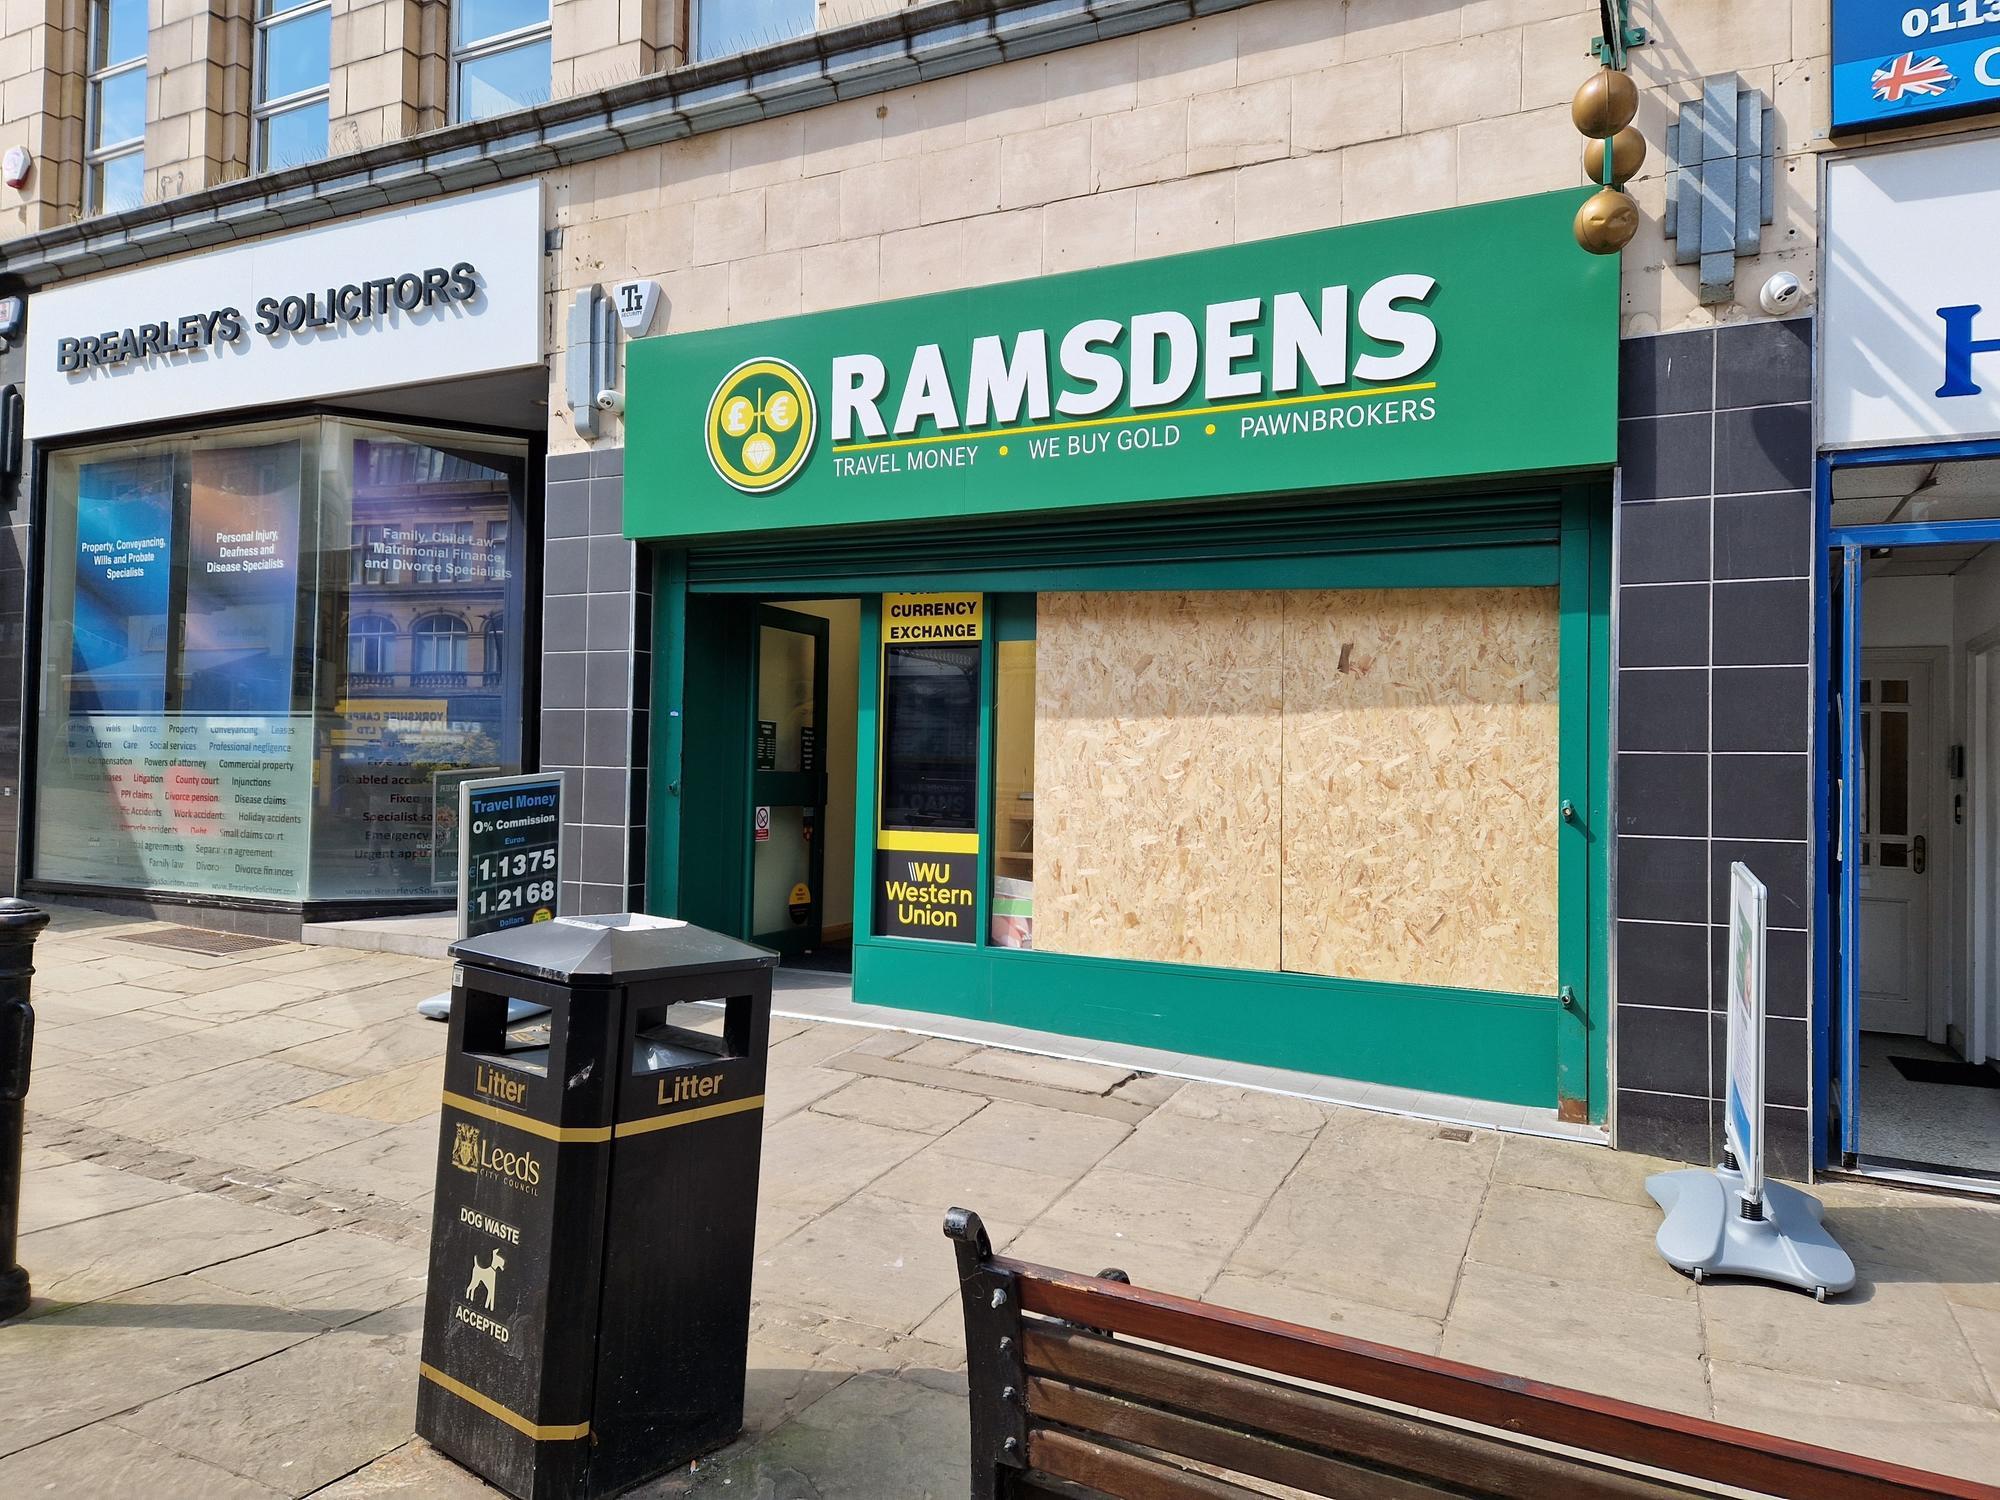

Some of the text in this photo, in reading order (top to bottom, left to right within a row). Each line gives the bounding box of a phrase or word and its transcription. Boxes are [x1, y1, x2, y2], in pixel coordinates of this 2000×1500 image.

[57, 261, 477, 373] BREARLEYS SOLICITORS
[831, 273, 1438, 441] RAMSDENS
[1240, 397, 1437, 438] PAWNBROKERS
[1028, 425, 1181, 460] WE BUY GOLD
[833, 445, 978, 477] TRAVEL MONEY
[82, 536, 166, 553] Property, Conveyancing,
[216, 529, 278, 543] Personal Injury,
[383, 527, 497, 549] Family, Child Law,
[94, 552, 154, 565] Wills and Probate
[219, 545, 275, 558] Deafness and
[373, 542, 505, 563] Matrimonial Finance,
[106, 567, 144, 580] Specialists
[206, 558, 284, 573] Disease Specialists
[364, 557, 513, 579] and Divorce Specialists
[890, 601, 977, 618] CURRENCY
[890, 624, 976, 640] EXCHANGE
[168, 724, 199, 735] Property
[123, 740, 139, 750] Care
[149, 740, 169, 751] Social
[170, 741, 197, 752] services
[209, 741, 252, 753] Professional
[253, 743, 293, 754] negligence
[144, 757, 168, 767] Powers
[169, 757, 177, 767] of
[178, 759, 207, 769] attorney
[218, 759, 261, 770] Commercial
[262, 761, 294, 772] property
[133, 773, 164, 785] Litigation
[175, 775, 200, 786] County
[201, 777, 220, 786] court
[231, 776, 272, 788] Injunctions
[120, 789, 287, 806] PPI claims Divorce pension Disease claims
[472, 793, 556, 814] Travel Money
[131, 806, 162, 817] Accidents
[174, 808, 192, 818] Work
[193, 810, 225, 820] accidents
[238, 811, 265, 824] Holiday
[266, 814, 302, 825] accidents
[362, 812, 418, 824] Specialist
[472, 814, 556, 835] 0% Commission
[220, 828, 239, 839] Small
[240, 829, 263, 840] claims
[365, 830, 428, 844] Emergency
[504, 836, 526, 846] Euros
[144, 842, 185, 853] agreements
[234, 845, 274, 858] agreement
[354, 849, 395, 861] Urgent
[149, 857, 170, 869] Family
[171, 858, 184, 869] law
[234, 863, 262, 874] Divorce
[479, 848, 556, 881] 1.1375
[912, 861, 951, 884] WU
[476, 880, 555, 915] 1.2168
[885, 880, 973, 907] Western
[499, 915, 526, 928] Dollars
[898, 904, 958, 928] Union
[476, 1063, 527, 1104] Litter
[657, 1072, 724, 1105] Litter
[480, 1138, 541, 1186] Leeds
[480, 1168, 539, 1197] CITY COUNCIL
[460, 1207, 521, 1246] DOG WASTE
[455, 1305, 510, 1343] ACCEPTED
